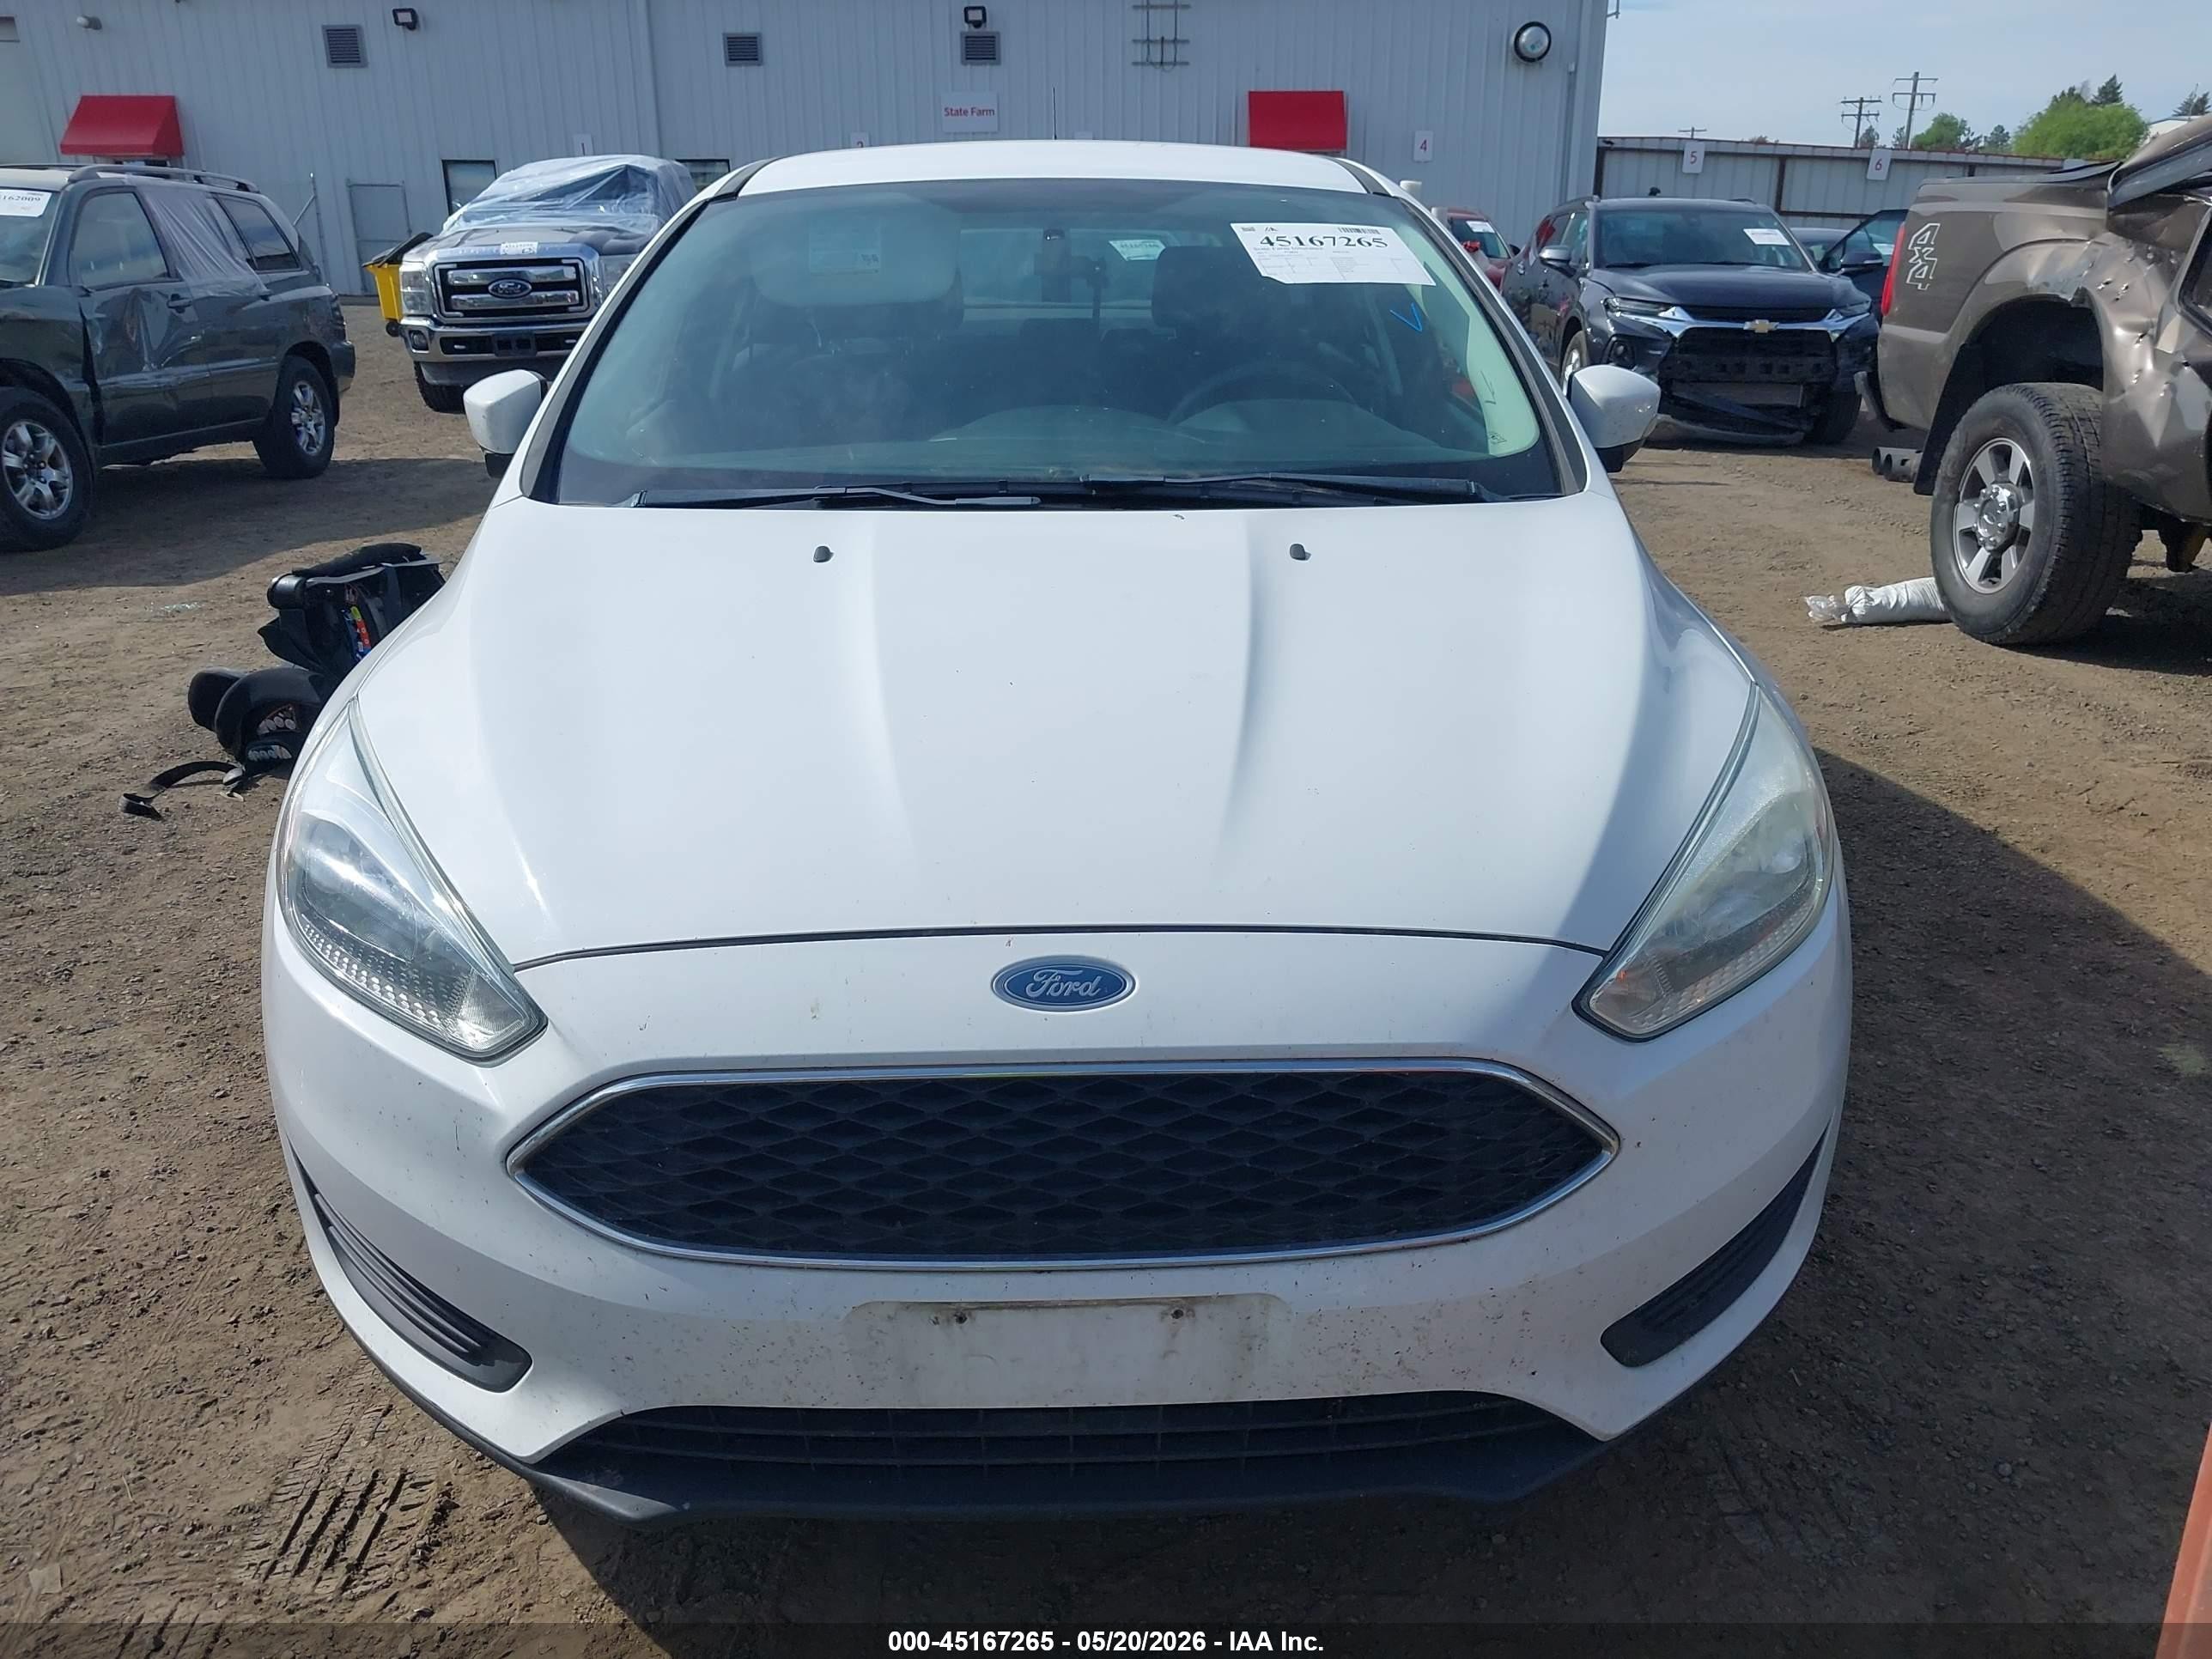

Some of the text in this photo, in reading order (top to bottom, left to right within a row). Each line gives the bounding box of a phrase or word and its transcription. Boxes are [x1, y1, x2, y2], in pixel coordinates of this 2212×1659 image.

[944, 106, 995, 117] State Farm
[1419, 138, 1427, 152] 4
[1689, 150, 1698, 165] 5
[1875, 158, 1882, 171] 6
[1260, 234, 1389, 248] 45167265
[1026, 969, 1102, 998] Ford
